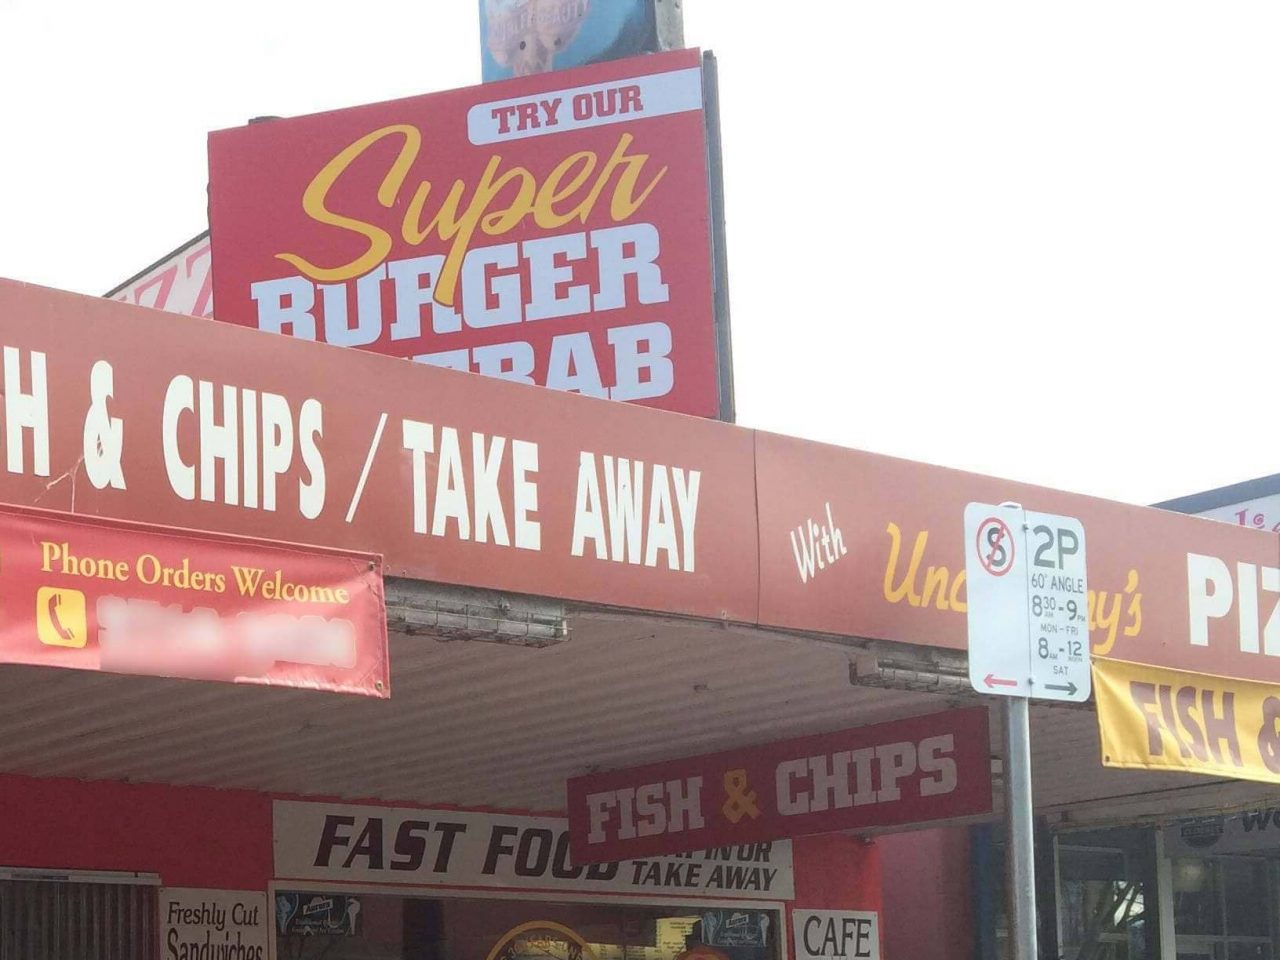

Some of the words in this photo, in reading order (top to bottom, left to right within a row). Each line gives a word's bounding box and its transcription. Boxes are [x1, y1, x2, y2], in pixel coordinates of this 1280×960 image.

[491, 100, 562, 134] TRY
[573, 85, 643, 120] OUR
[274, 124, 668, 307] Super
[251, 222, 669, 348] BURGER
[402, 321, 674, 401] BAB
[83, 360, 126, 490] &
[162, 374, 326, 519] CHIPS
[345, 412, 388, 523] /
[402, 419, 540, 551] TAKE
[571, 451, 701, 573] AWAY
[40, 541, 129, 582] Phone
[136, 554, 226, 594] Orders
[232, 566, 349, 605] Welcome
[1032, 524, 1079, 570] 2P
[790, 502, 848, 584] With
[883, 521, 968, 614] Unc
[1187, 552, 1280, 658] PIZ
[1051, 575, 1084, 594] ANGLE
[1040, 624, 1058, 633] MON
[1065, 626, 1079, 635] FRI
[1067, 640, 1082, 657] 12
[1053, 666, 1069, 675] SAT
[1130, 680, 1244, 767] FISH
[586, 776, 704, 844] FISH
[721, 768, 761, 824] &
[775, 734, 957, 816] CHIPS
[313, 814, 467, 873] FAST
[632, 861, 702, 888] TAKE
[705, 865, 778, 891] AWAY
[168, 902, 226, 931] Freshly
[232, 903, 259, 926] Cut
[803, 915, 871, 958] CAFE
